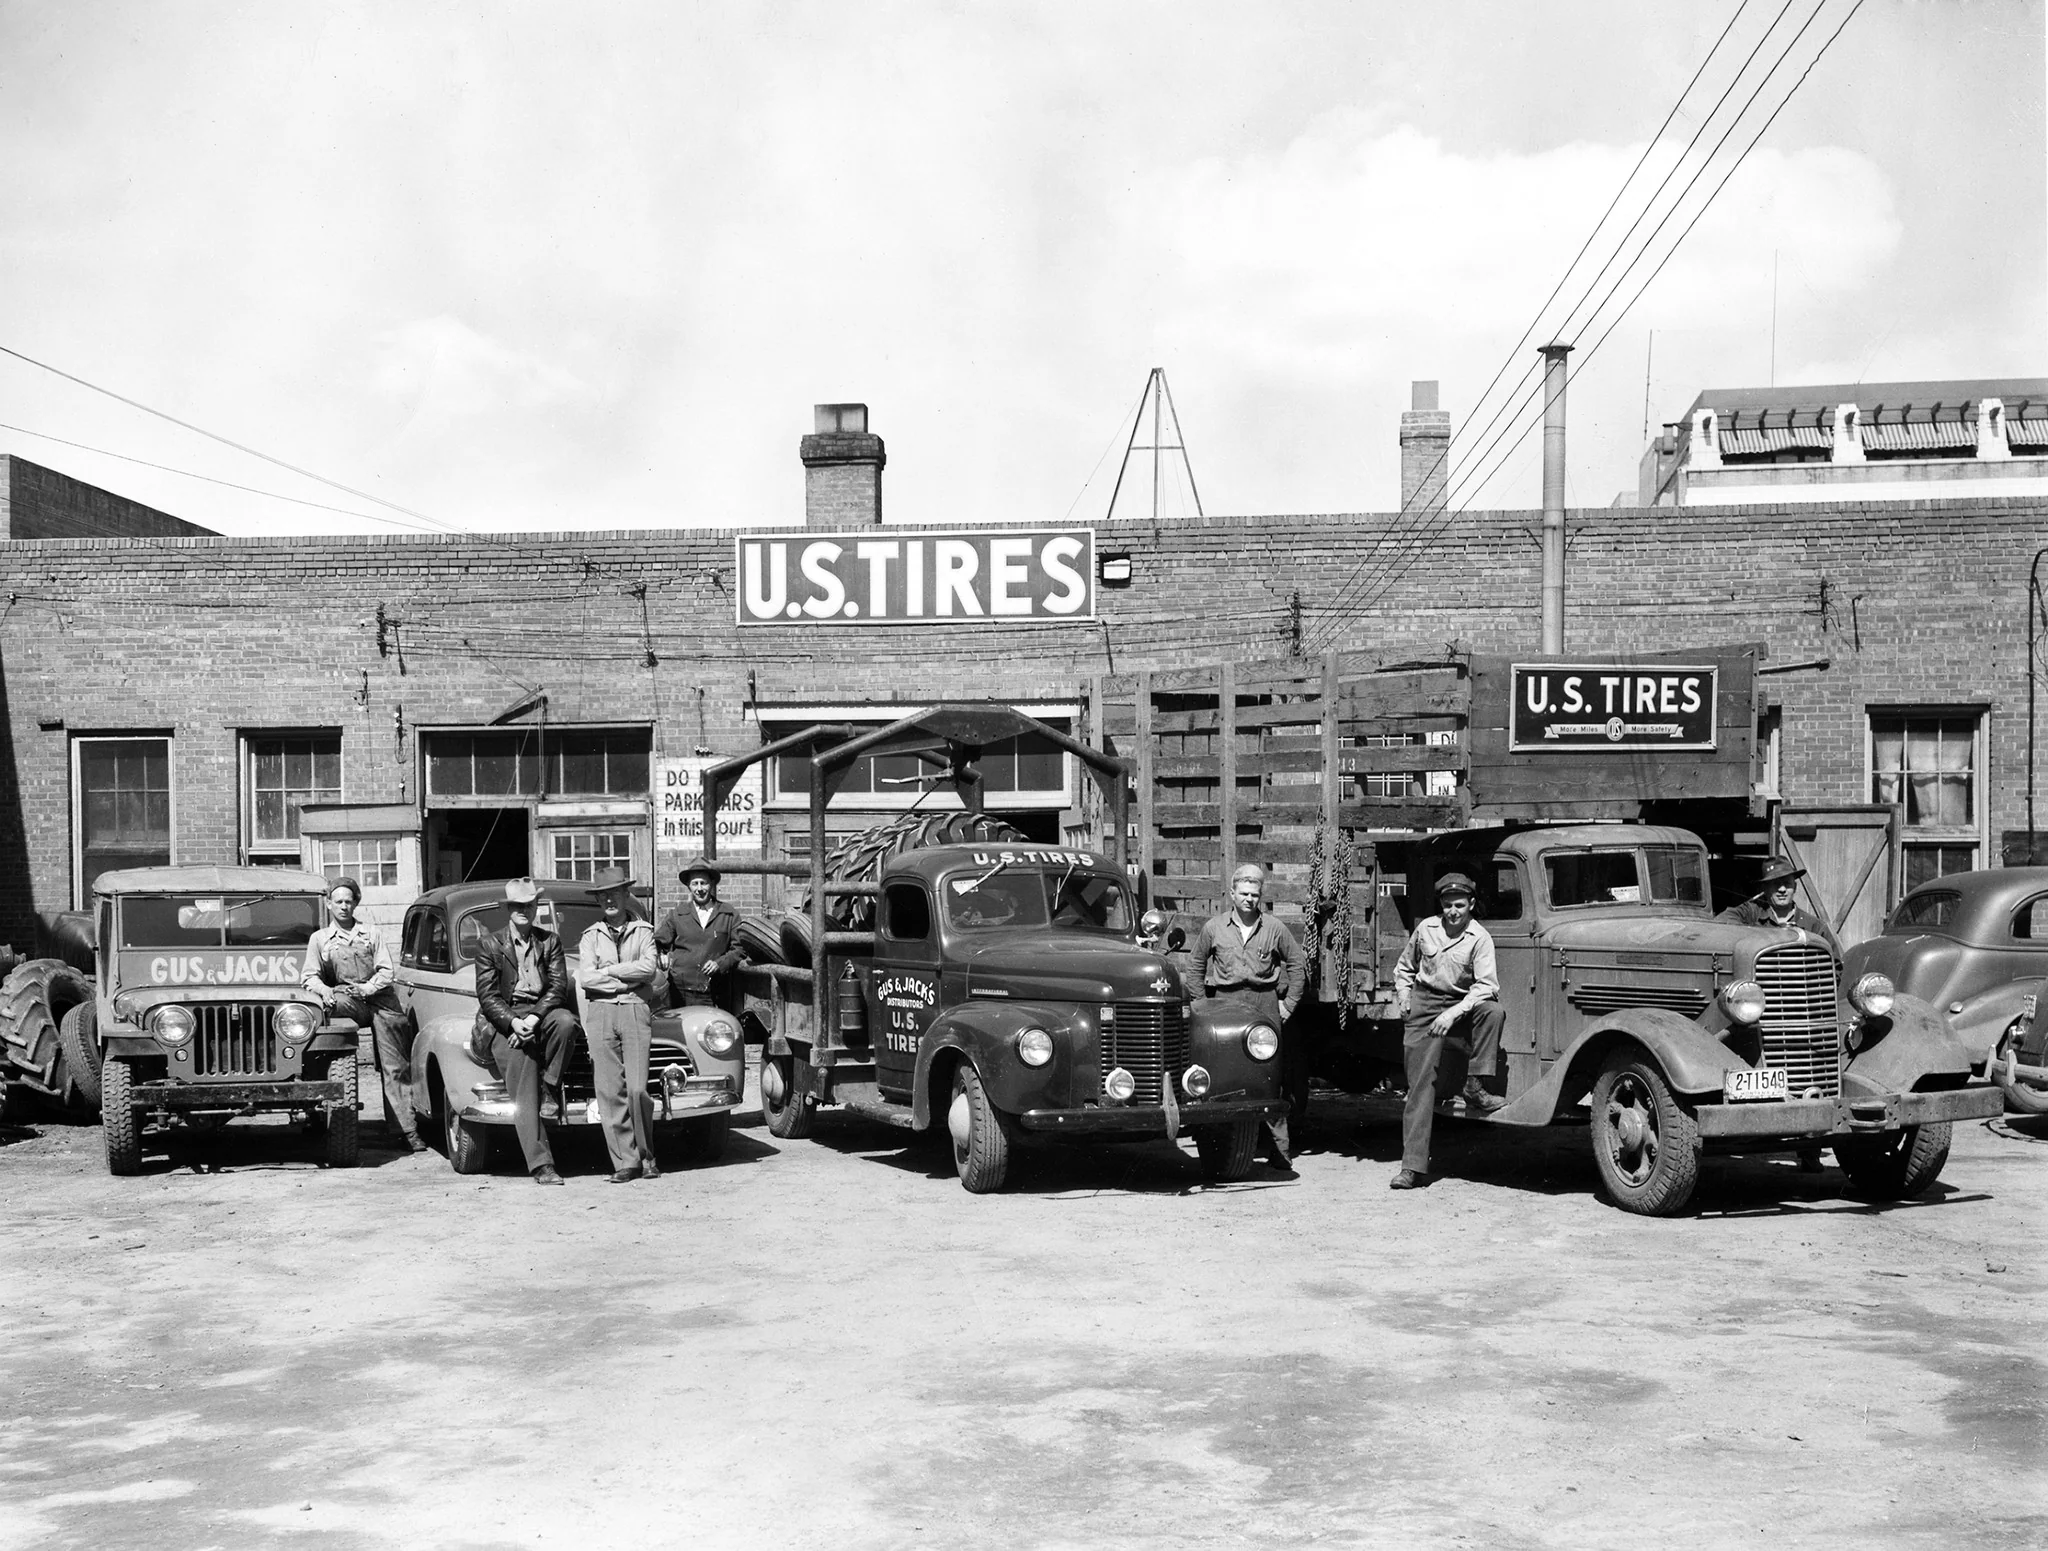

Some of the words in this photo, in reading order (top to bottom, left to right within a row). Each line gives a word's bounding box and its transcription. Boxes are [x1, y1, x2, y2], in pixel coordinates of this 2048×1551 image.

[745, 541, 859, 619] U.S.
[857, 536, 1087, 617] TIRES
[1527, 676, 1592, 714] U.S.
[1600, 676, 1701, 714] TIRES
[1650, 726, 1671, 734] Safety
[667, 769, 689, 787] DO
[665, 793, 704, 811] PARK
[721, 793, 754, 811] ARS
[664, 818, 676, 836] in
[679, 818, 704, 836] this
[716, 818, 754, 835] ourt
[1023, 851, 1094, 867] TIRES
[151, 956, 204, 983] GUS
[217, 951, 300, 983] JACK'S
[877, 978, 894, 1001] GUS
[894, 977, 902, 993] &
[902, 976, 936, 1006] JACK'S
[887, 997, 924, 1009] DISTRIBUTORS
[892, 1011, 919, 1031] U.S.
[1736, 1071, 1785, 1091] 2-T1549
